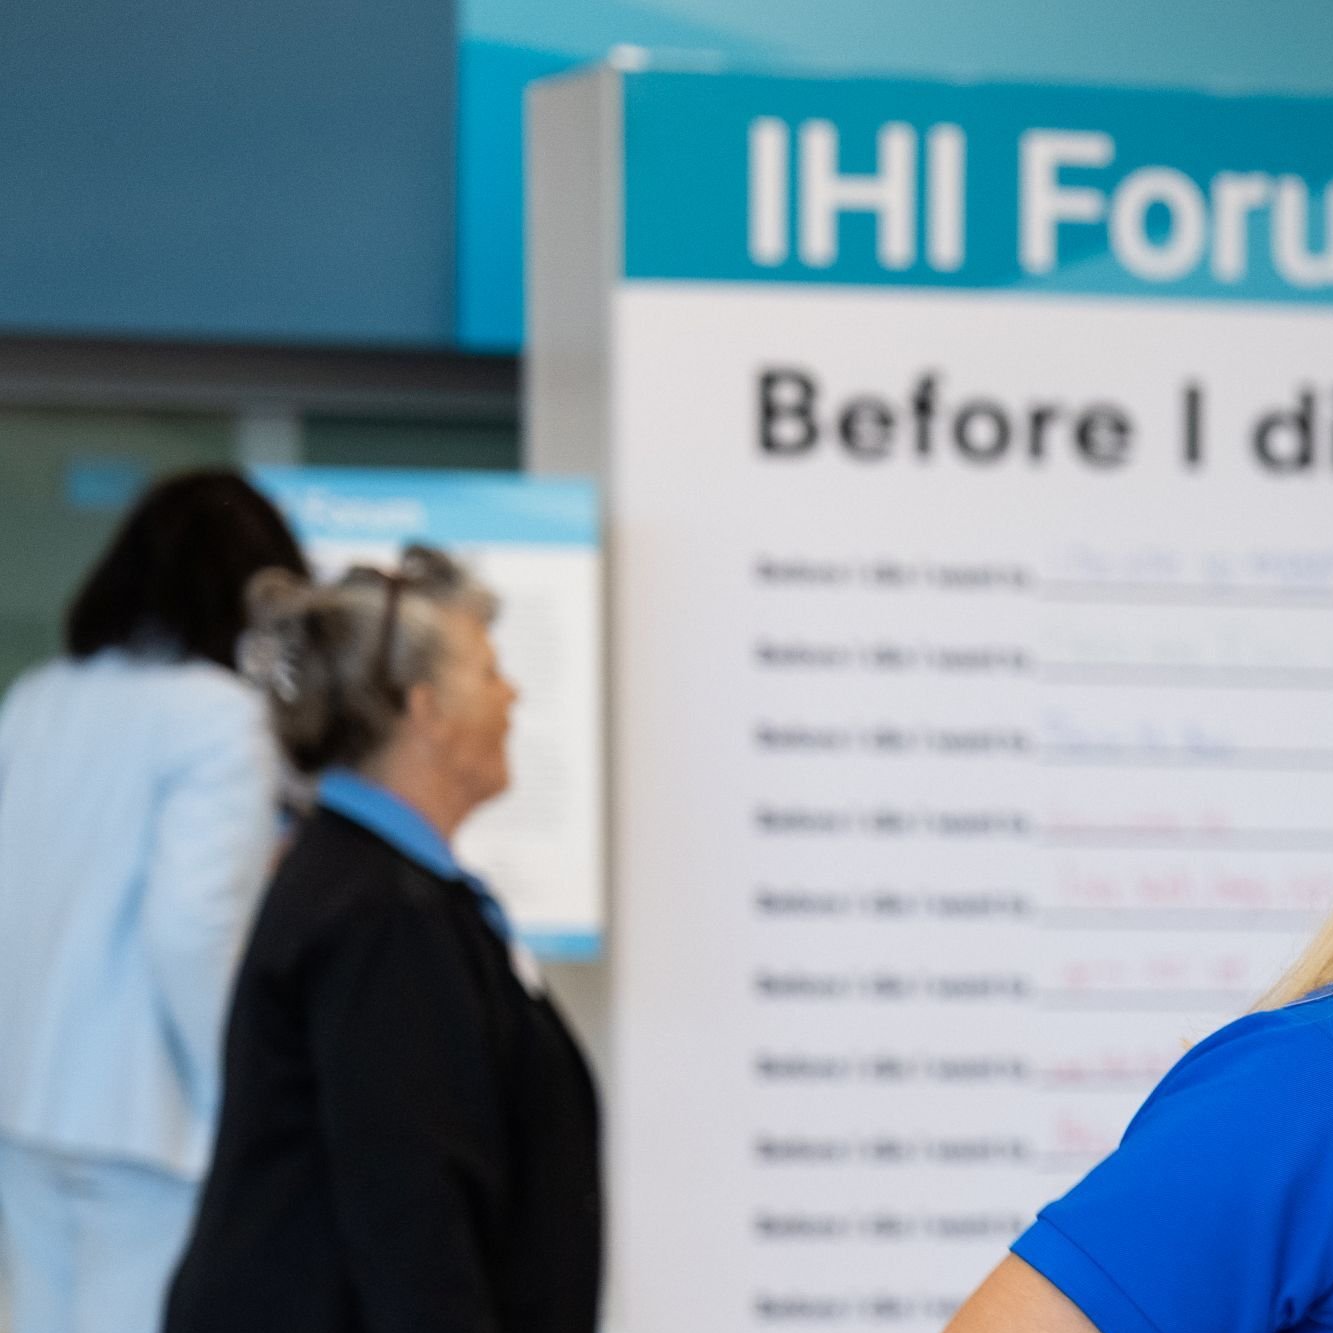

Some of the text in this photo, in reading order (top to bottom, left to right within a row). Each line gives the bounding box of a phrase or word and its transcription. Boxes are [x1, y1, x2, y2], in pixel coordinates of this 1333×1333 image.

[748, 115, 967, 273] IHI
[755, 366, 1135, 469] Before
[1182, 376, 1206, 472] I
